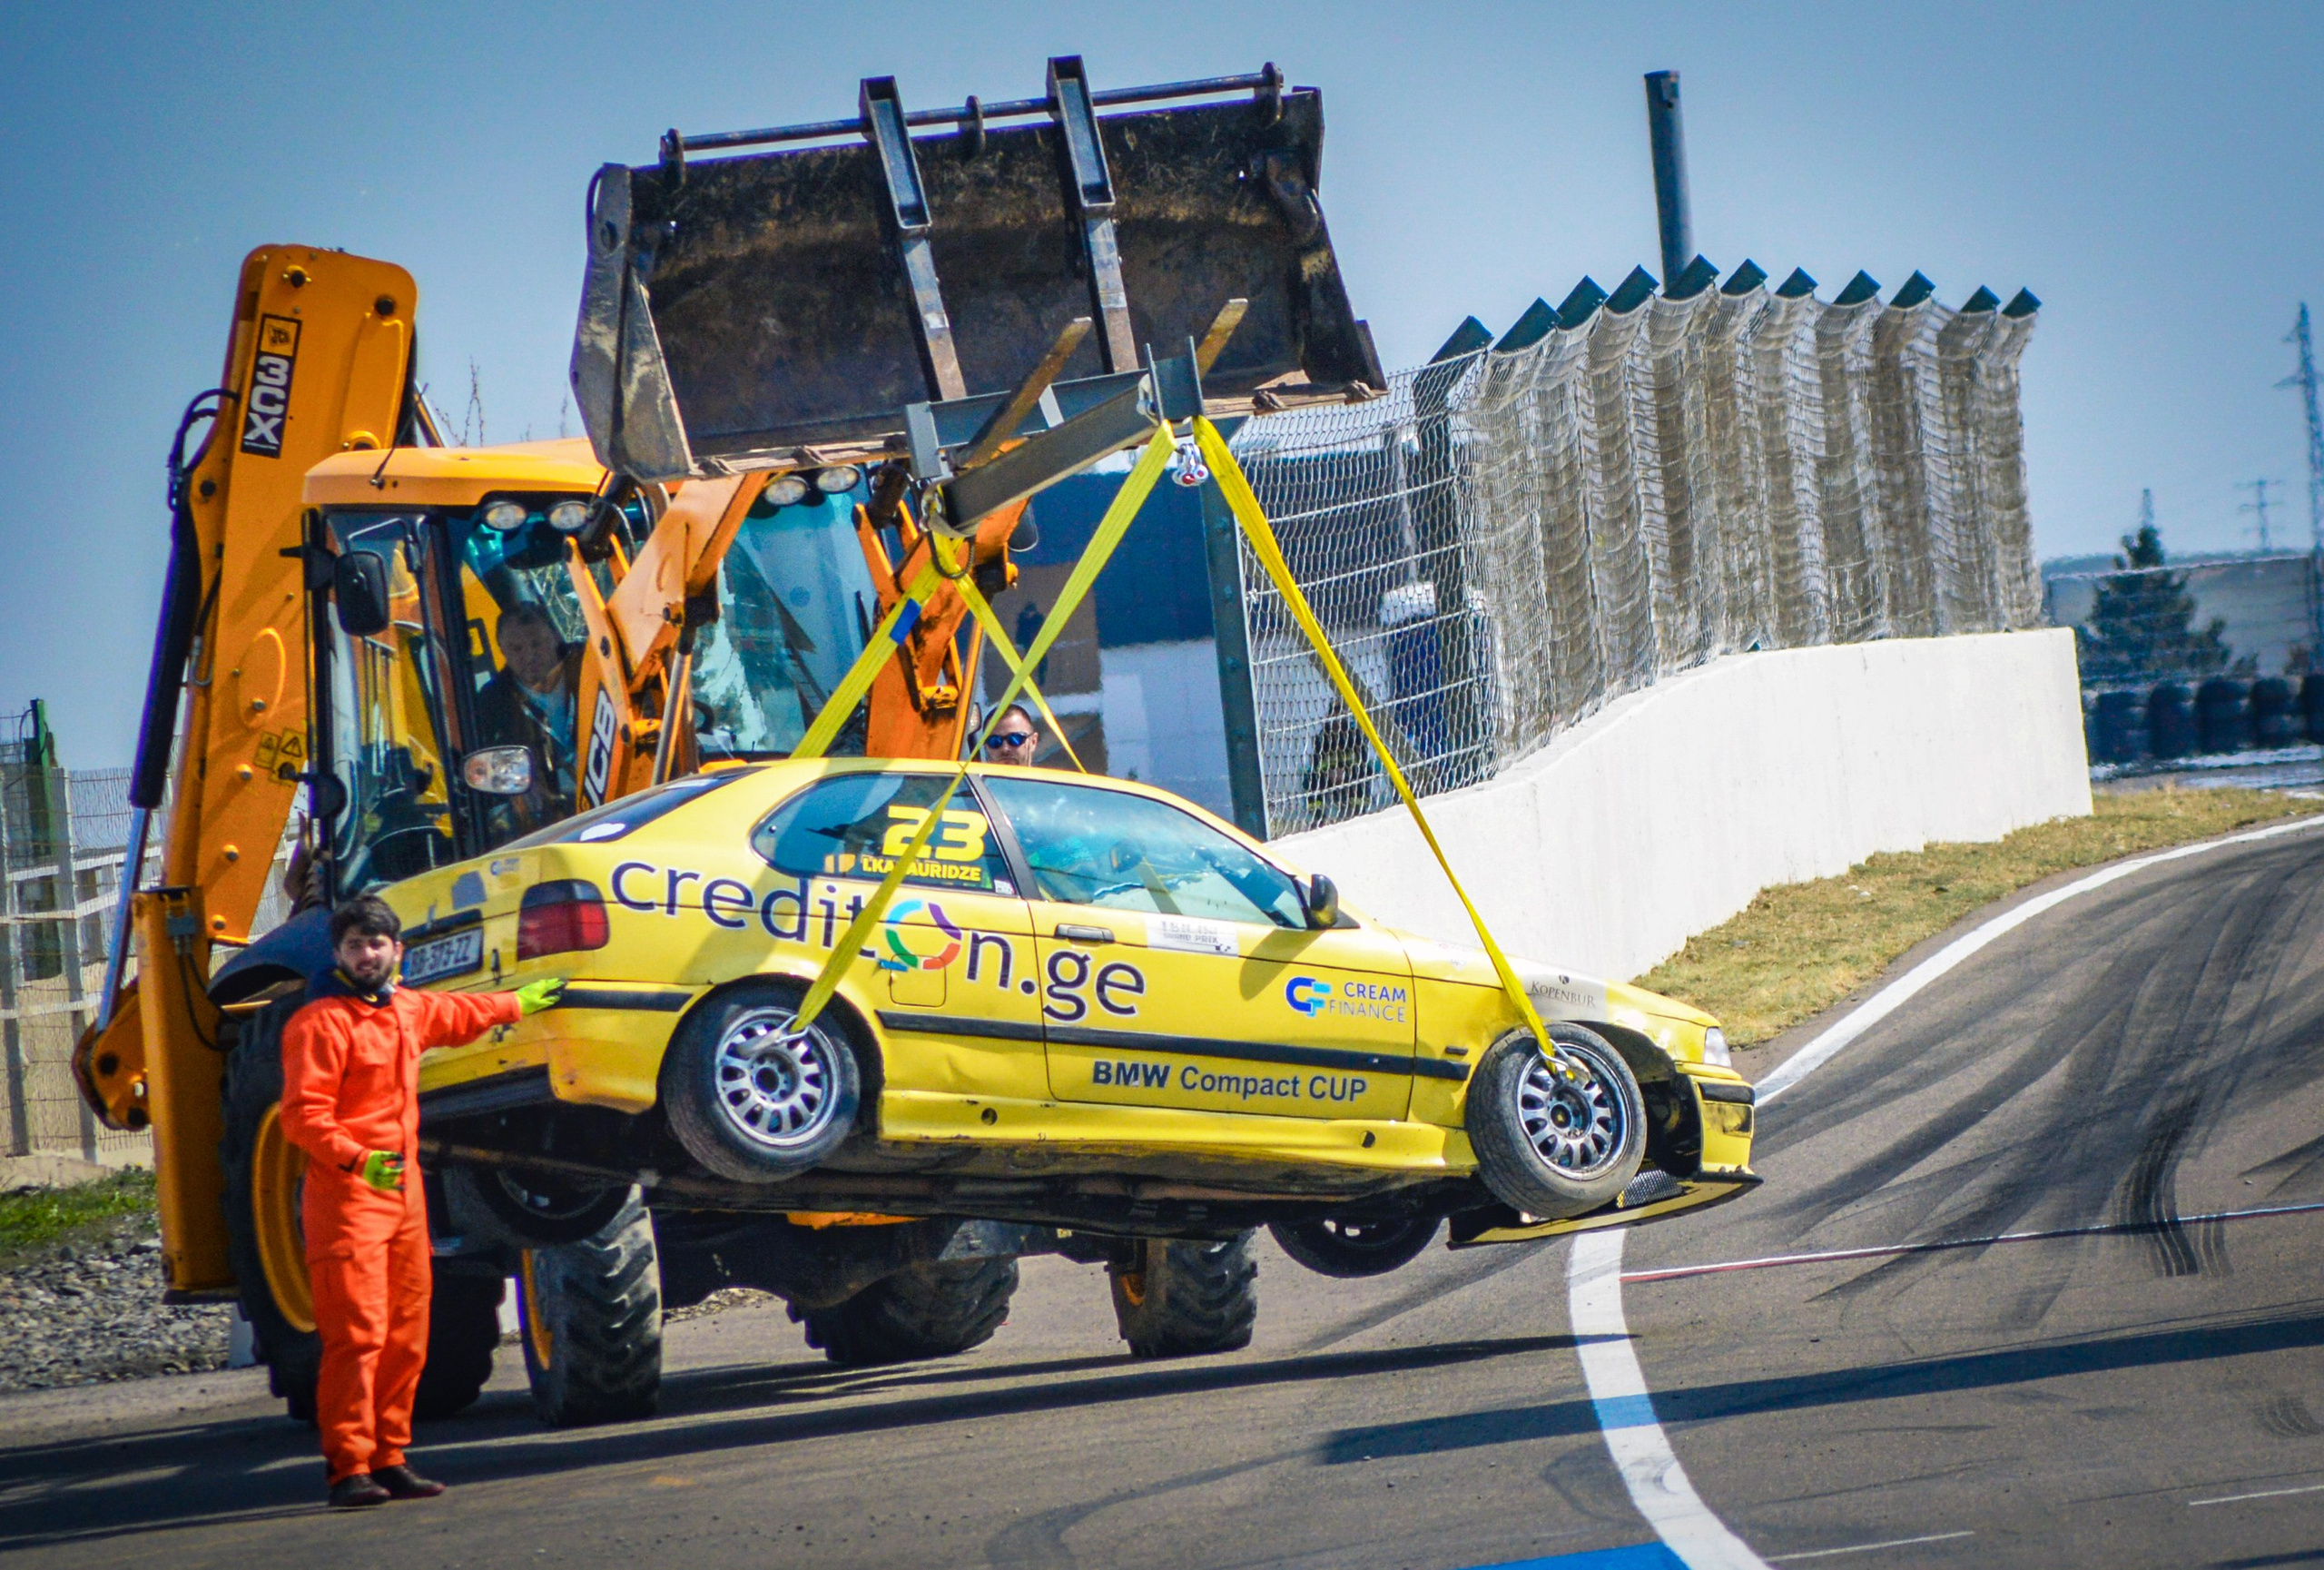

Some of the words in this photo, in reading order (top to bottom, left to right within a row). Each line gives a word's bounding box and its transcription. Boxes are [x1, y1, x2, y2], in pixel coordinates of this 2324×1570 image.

[243, 355, 290, 445] 3CX
[882, 805, 989, 862] 23
[862, 857, 981, 882] I.KAAURIDZE
[1344, 982, 1406, 1002] CREAM
[1329, 999, 1406, 1022] FINANCE
[1092, 1061, 1171, 1089] BMW
[1180, 1065, 1300, 1101] Compact
[1308, 1075, 1367, 1102] CUP
